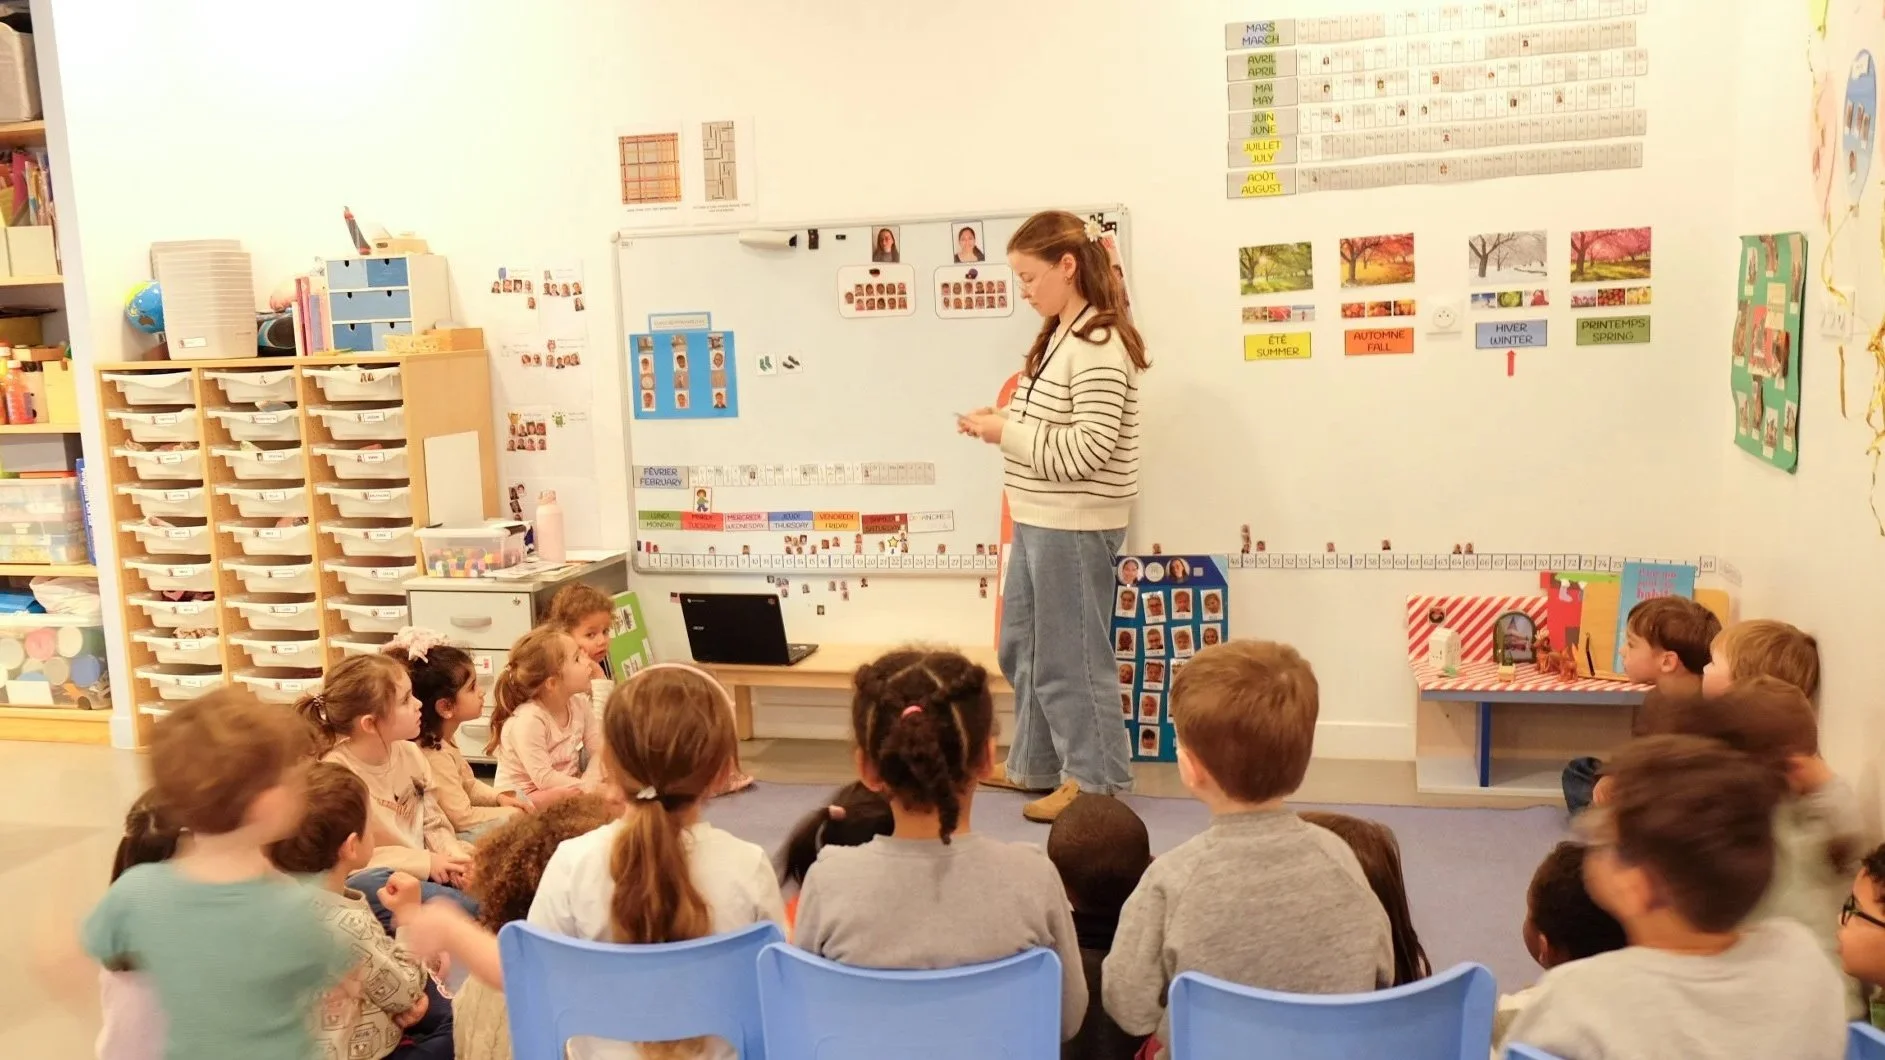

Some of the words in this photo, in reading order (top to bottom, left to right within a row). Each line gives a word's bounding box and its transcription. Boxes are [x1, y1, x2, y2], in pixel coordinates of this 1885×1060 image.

[1246, 22, 1276, 33] MARS
[1242, 34, 1280, 46] MARCH
[1247, 53, 1276, 65] AVRIL
[1247, 66, 1276, 77] APRIL
[1255, 83, 1273, 93] MAI
[1252, 95, 1274, 106] MAY
[1252, 112, 1274, 122] JUIN
[1250, 125, 1276, 135] JUNE
[1244, 140, 1280, 151] JUILLET
[1251, 153, 1274, 163] JULY
[1247, 170, 1276, 182] AOÛT
[1241, 184, 1283, 195] AUGUST
[1495, 323, 1528, 333] HIVER
[1581, 318, 1646, 330] PRINTEMPS
[1268, 333, 1287, 345] ÉTÉ
[1353, 330, 1406, 341] AUTOMNE
[1490, 335, 1533, 346] WINTER
[1592, 331, 1634, 343] SPRING
[1256, 347, 1300, 357] SUMMER
[1366, 342, 1392, 352] FALL
[643, 466, 678, 476] FÉVRIER
[639, 478, 683, 487] FEBRUARY
[727, 513, 761, 521] MERCREDI
[781, 512, 800, 520] JEUDI
[819, 513, 854, 521] VENDREDI
[646, 521, 675, 529] MONDAY
[774, 521, 809, 529] THURSDAY
[1244, 558, 1254, 566] 49
[1258, 558, 1268, 566] 50
[1272, 558, 1281, 566] 51
[1285, 558, 1294, 566] 52
[1311, 558, 1321, 566] 54
[1325, 558, 1335, 566] 55
[1339, 558, 1349, 566] 56
[1353, 558, 1363, 567] 57
[1367, 558, 1377, 567] 58
[1381, 558, 1391, 567] 59
[1394, 558, 1405, 567] 60
[1409, 558, 1419, 567] 61
[1423, 558, 1433, 567] 62
[1438, 558, 1448, 567] 63
[1452, 558, 1462, 567] 64
[1465, 558, 1475, 567] 65
[1479, 558, 1489, 567] 66
[1494, 558, 1504, 567] 67
[1508, 558, 1519, 567] 68
[1523, 558, 1534, 567] 69
[1538, 558, 1548, 567] 70
[1553, 558, 1562, 567] 71
[1567, 558, 1577, 567] 72
[1583, 559, 1593, 568] 73
[1597, 560, 1607, 569] 74
